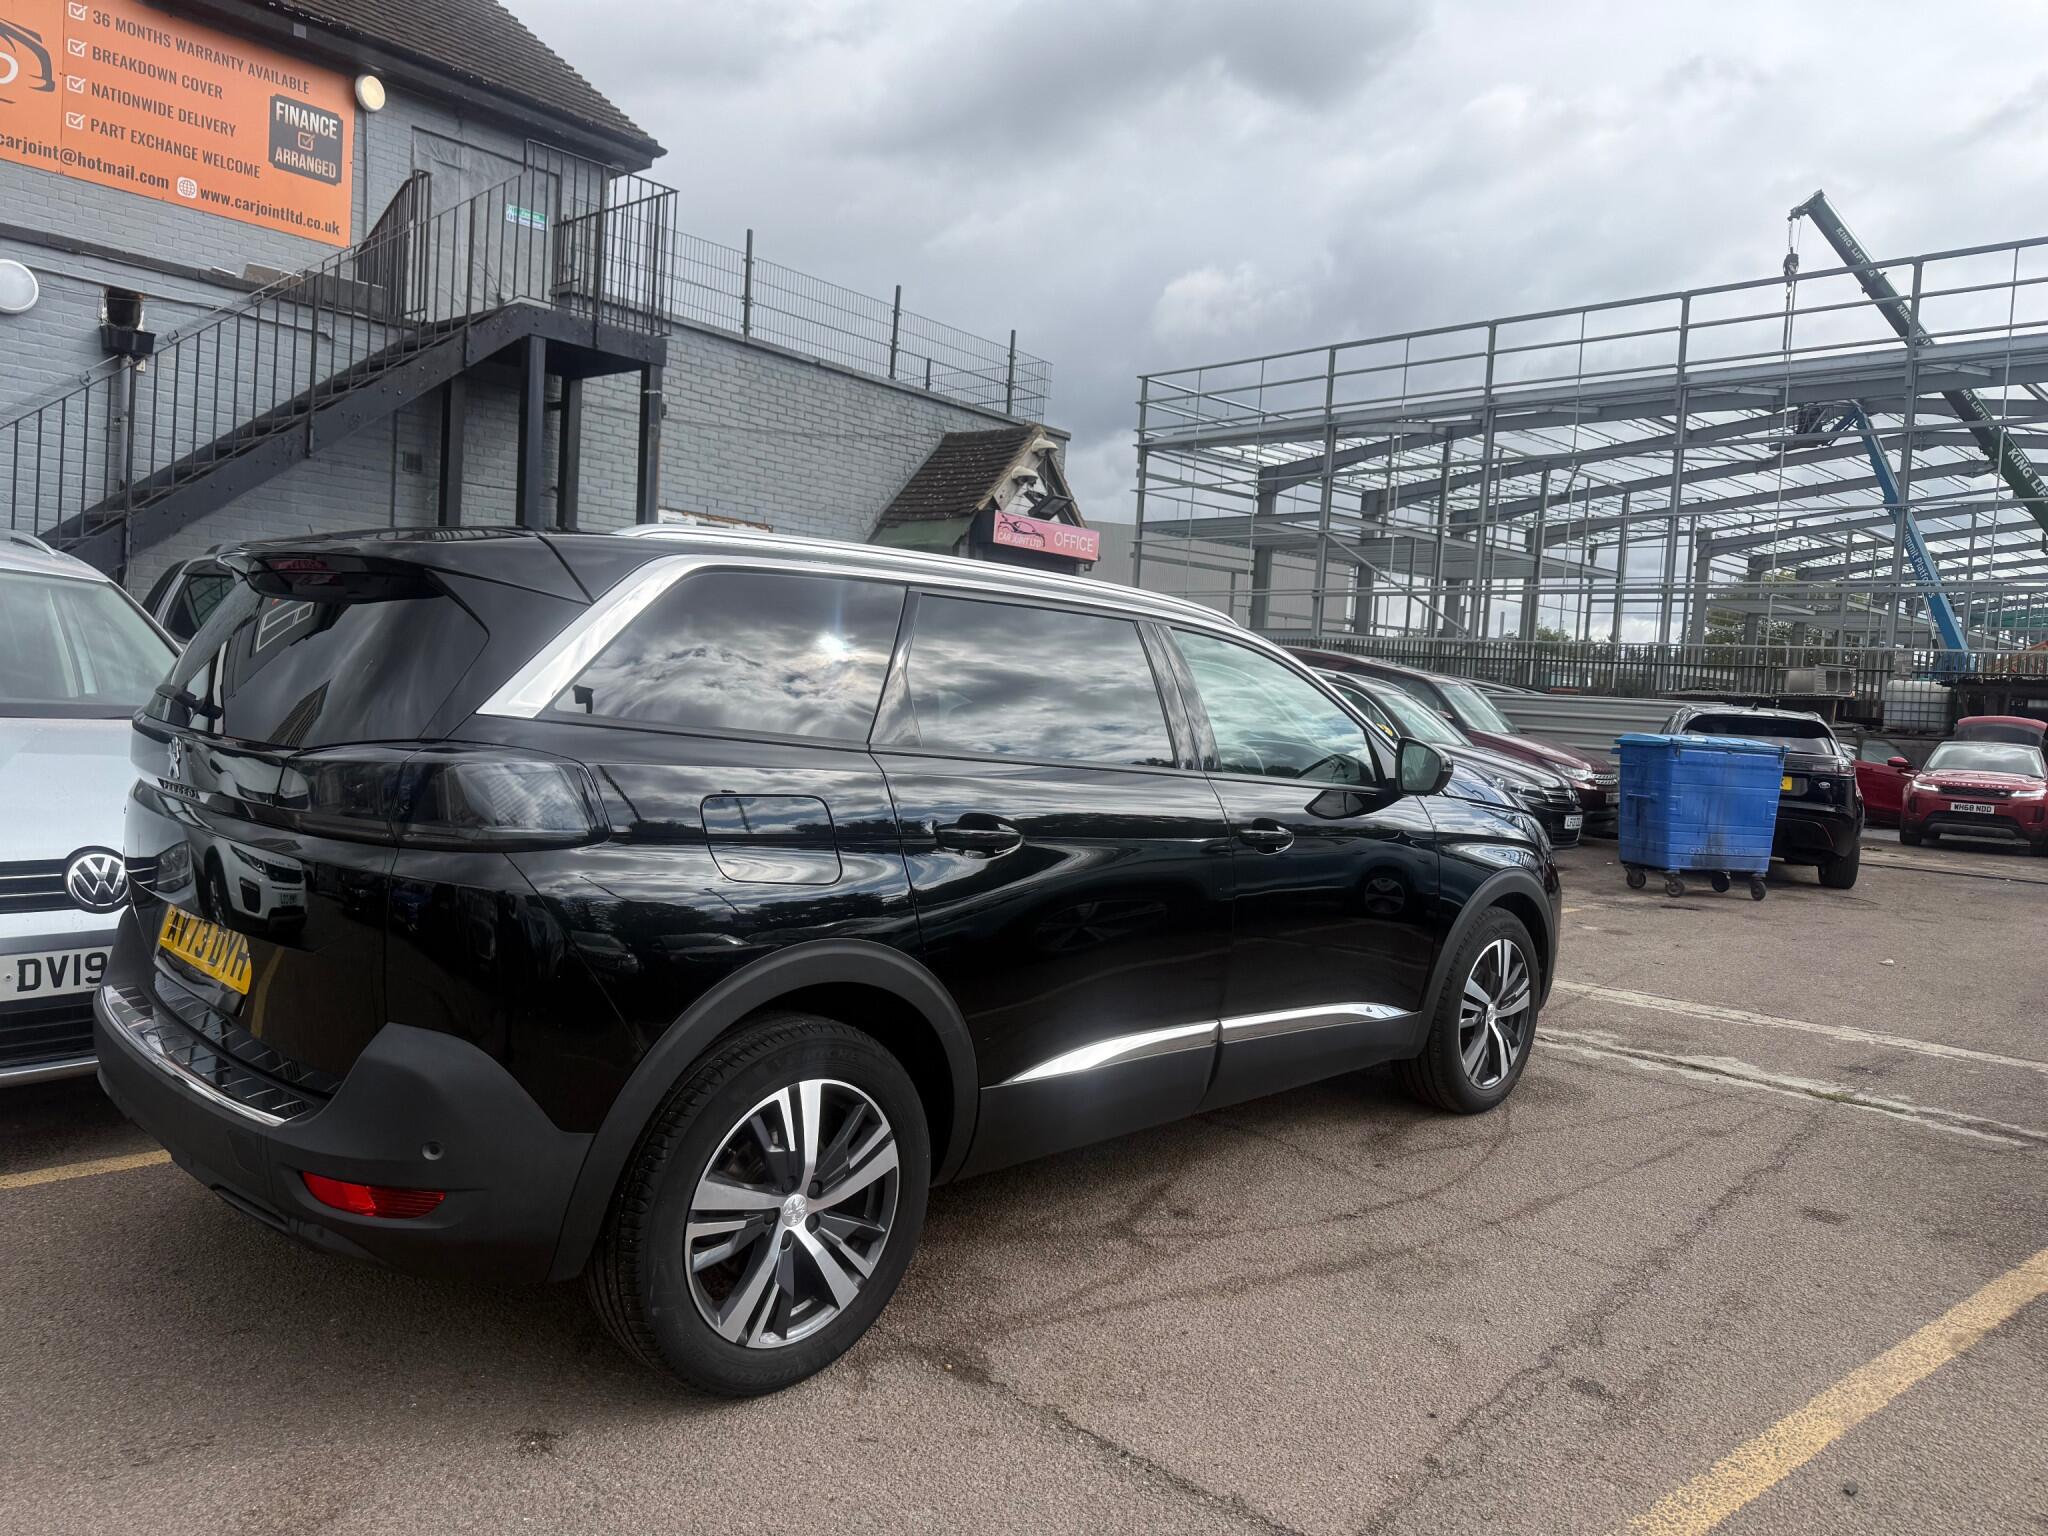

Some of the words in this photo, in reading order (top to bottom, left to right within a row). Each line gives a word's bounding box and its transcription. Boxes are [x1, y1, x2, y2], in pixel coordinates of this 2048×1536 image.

[92, 10, 110, 28] 36
[115, 17, 171, 48] MONTHS
[176, 37, 244, 73] WARRANTY
[247, 63, 310, 95] AVAILABLE
[92, 46, 177, 85] BREAKDOWN
[181, 74, 223, 99] COVER
[91, 84, 174, 120] NATIONWIDE
[178, 108, 236, 137] DELIVERY
[275, 101, 338, 139] FINANCE
[90, 118, 126, 141] PART
[130, 130, 199, 161] EXCHANGE
[202, 150, 261, 179] WELCOME
[275, 146, 337, 179] ARRANGED
[200, 188, 340, 236] www.carjointltd.co.uk
[1836, 227, 1853, 248] KING
[1851, 247, 1876, 278] LIFTG
[2007, 448, 2033, 479] KING
[997, 531, 1011, 542] CAR
[1054, 531, 1094, 553] OFFICE
[17, 951, 108, 993] DV19
